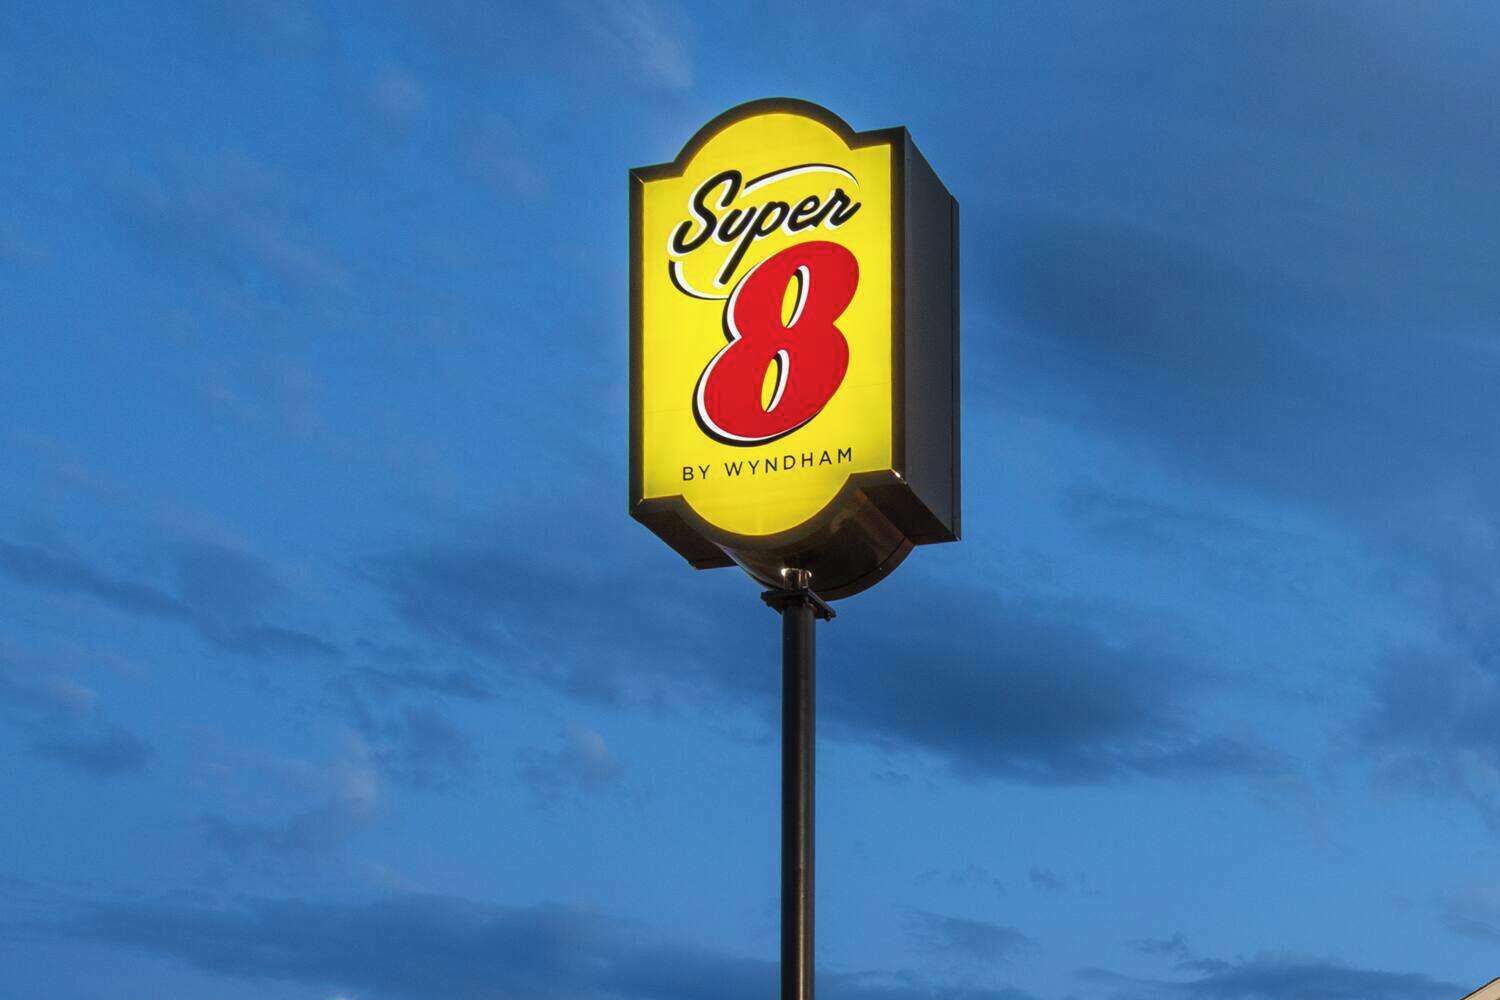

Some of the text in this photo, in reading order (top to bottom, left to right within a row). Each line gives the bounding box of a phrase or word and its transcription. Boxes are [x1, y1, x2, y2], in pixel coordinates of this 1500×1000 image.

[668, 168, 862, 286] Super
[692, 240, 859, 447] 8
[682, 447, 852, 480] BY WYNDHAM
